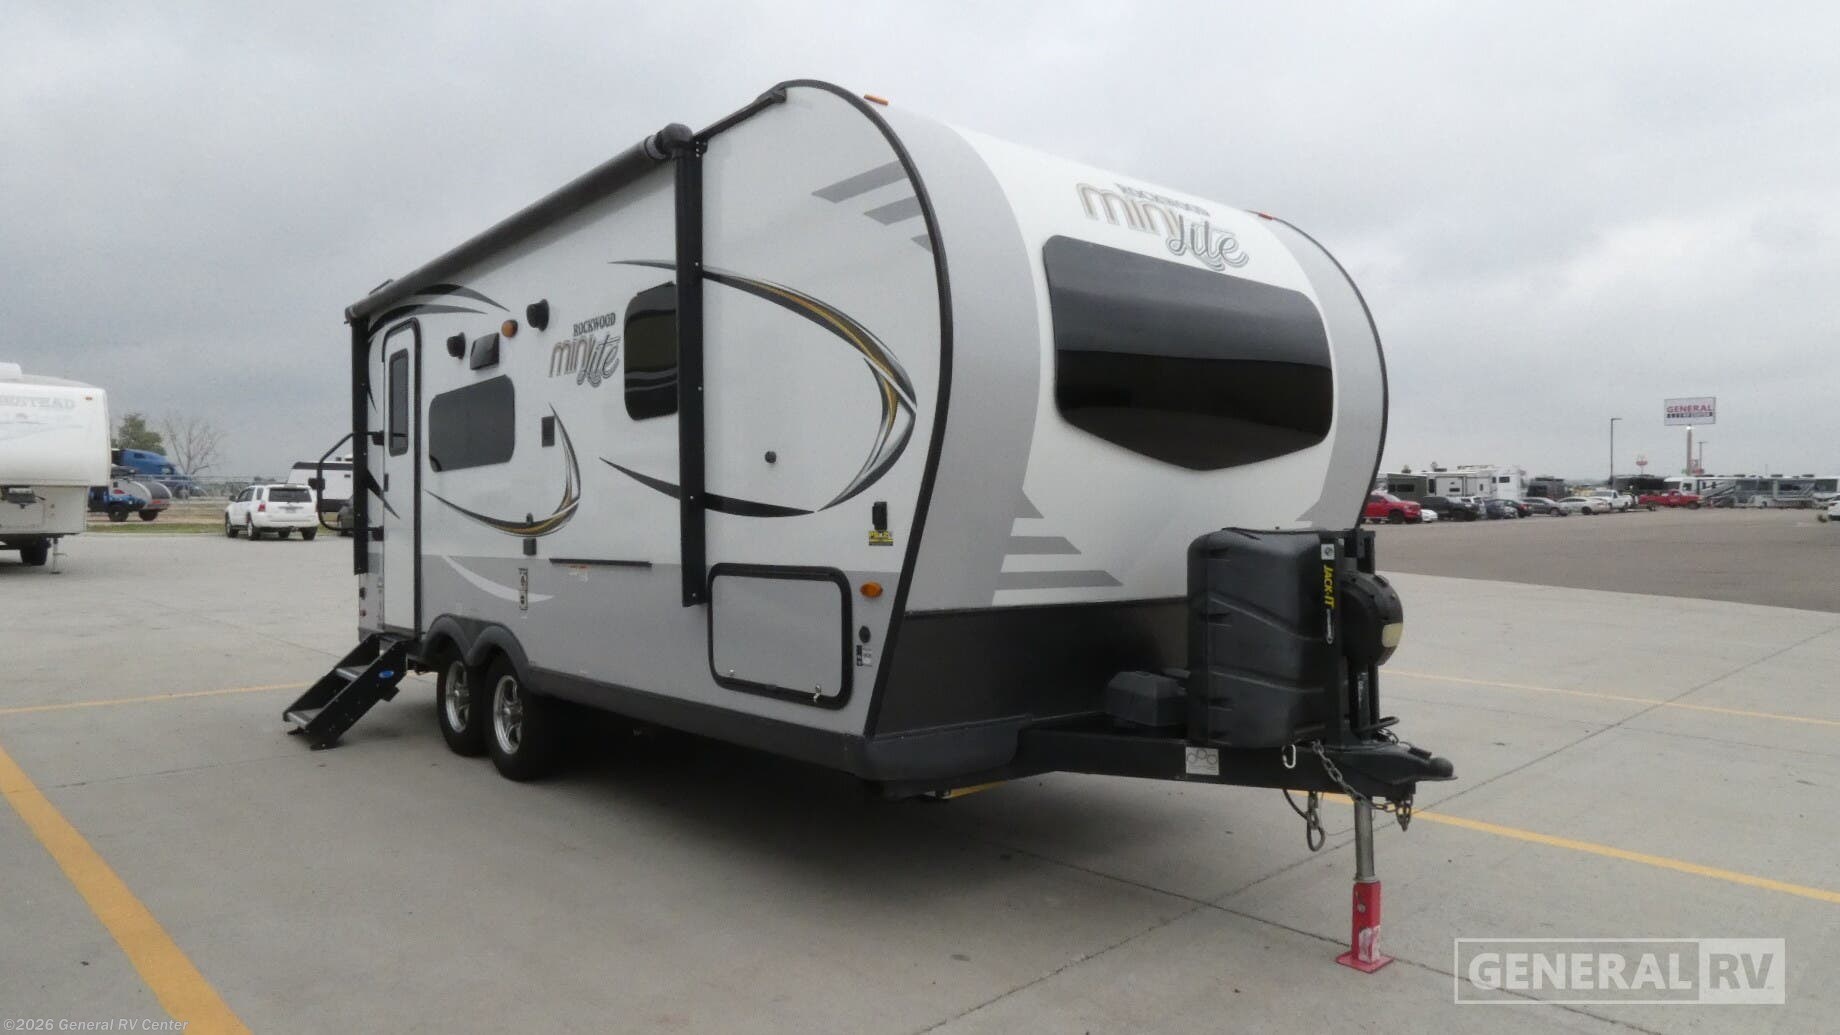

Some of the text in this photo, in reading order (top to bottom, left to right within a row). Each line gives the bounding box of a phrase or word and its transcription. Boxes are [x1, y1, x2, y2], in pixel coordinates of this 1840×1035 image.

[573, 312, 616, 336] ROCKWOOD
[1666, 404, 1712, 413] GENERAL
[1323, 564, 1335, 609] JACK-IT
